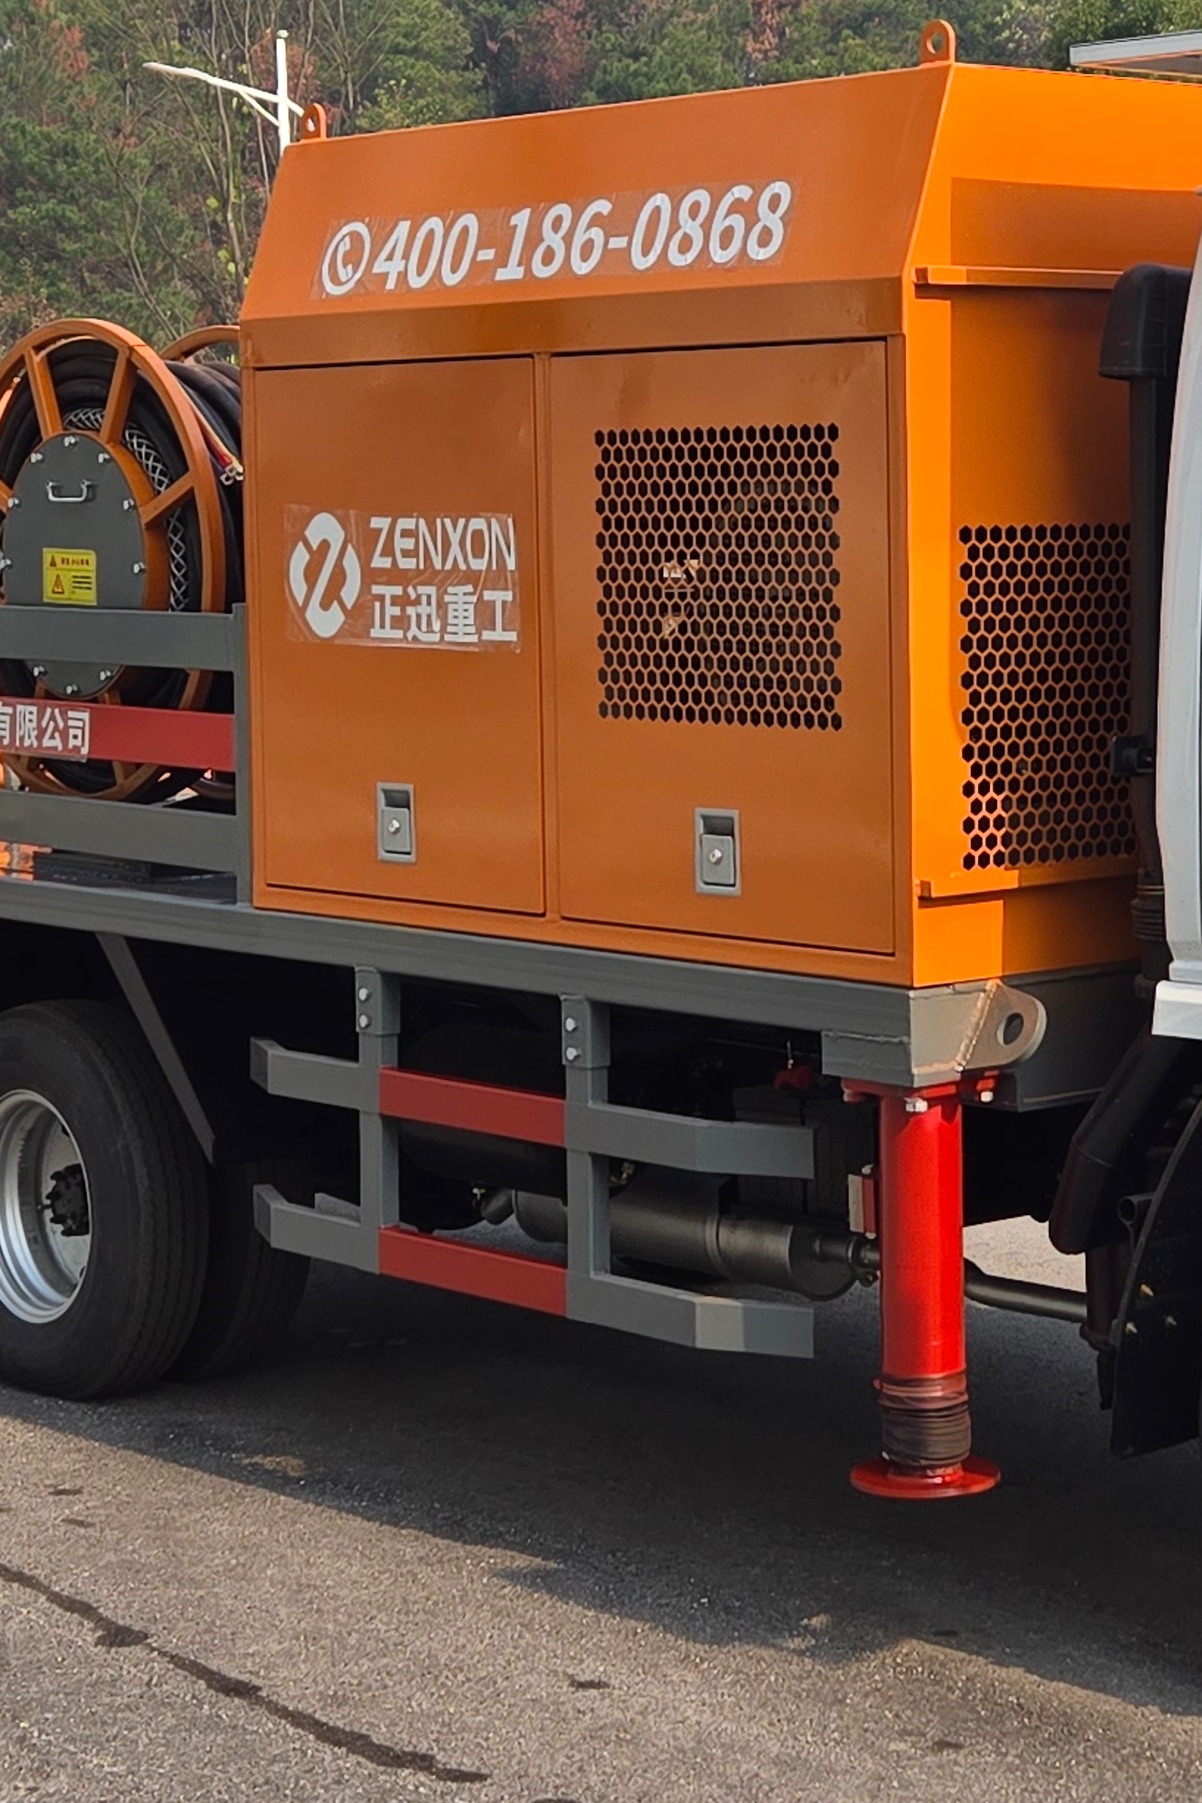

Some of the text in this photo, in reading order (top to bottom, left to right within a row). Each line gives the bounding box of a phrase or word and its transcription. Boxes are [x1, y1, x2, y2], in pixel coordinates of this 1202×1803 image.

[372, 181, 792, 290] 400-186-0868
[370, 516, 516, 571] ZENXON
[369, 584, 518, 642] 正迅重工
[0, 701, 90, 755] 有限公司
